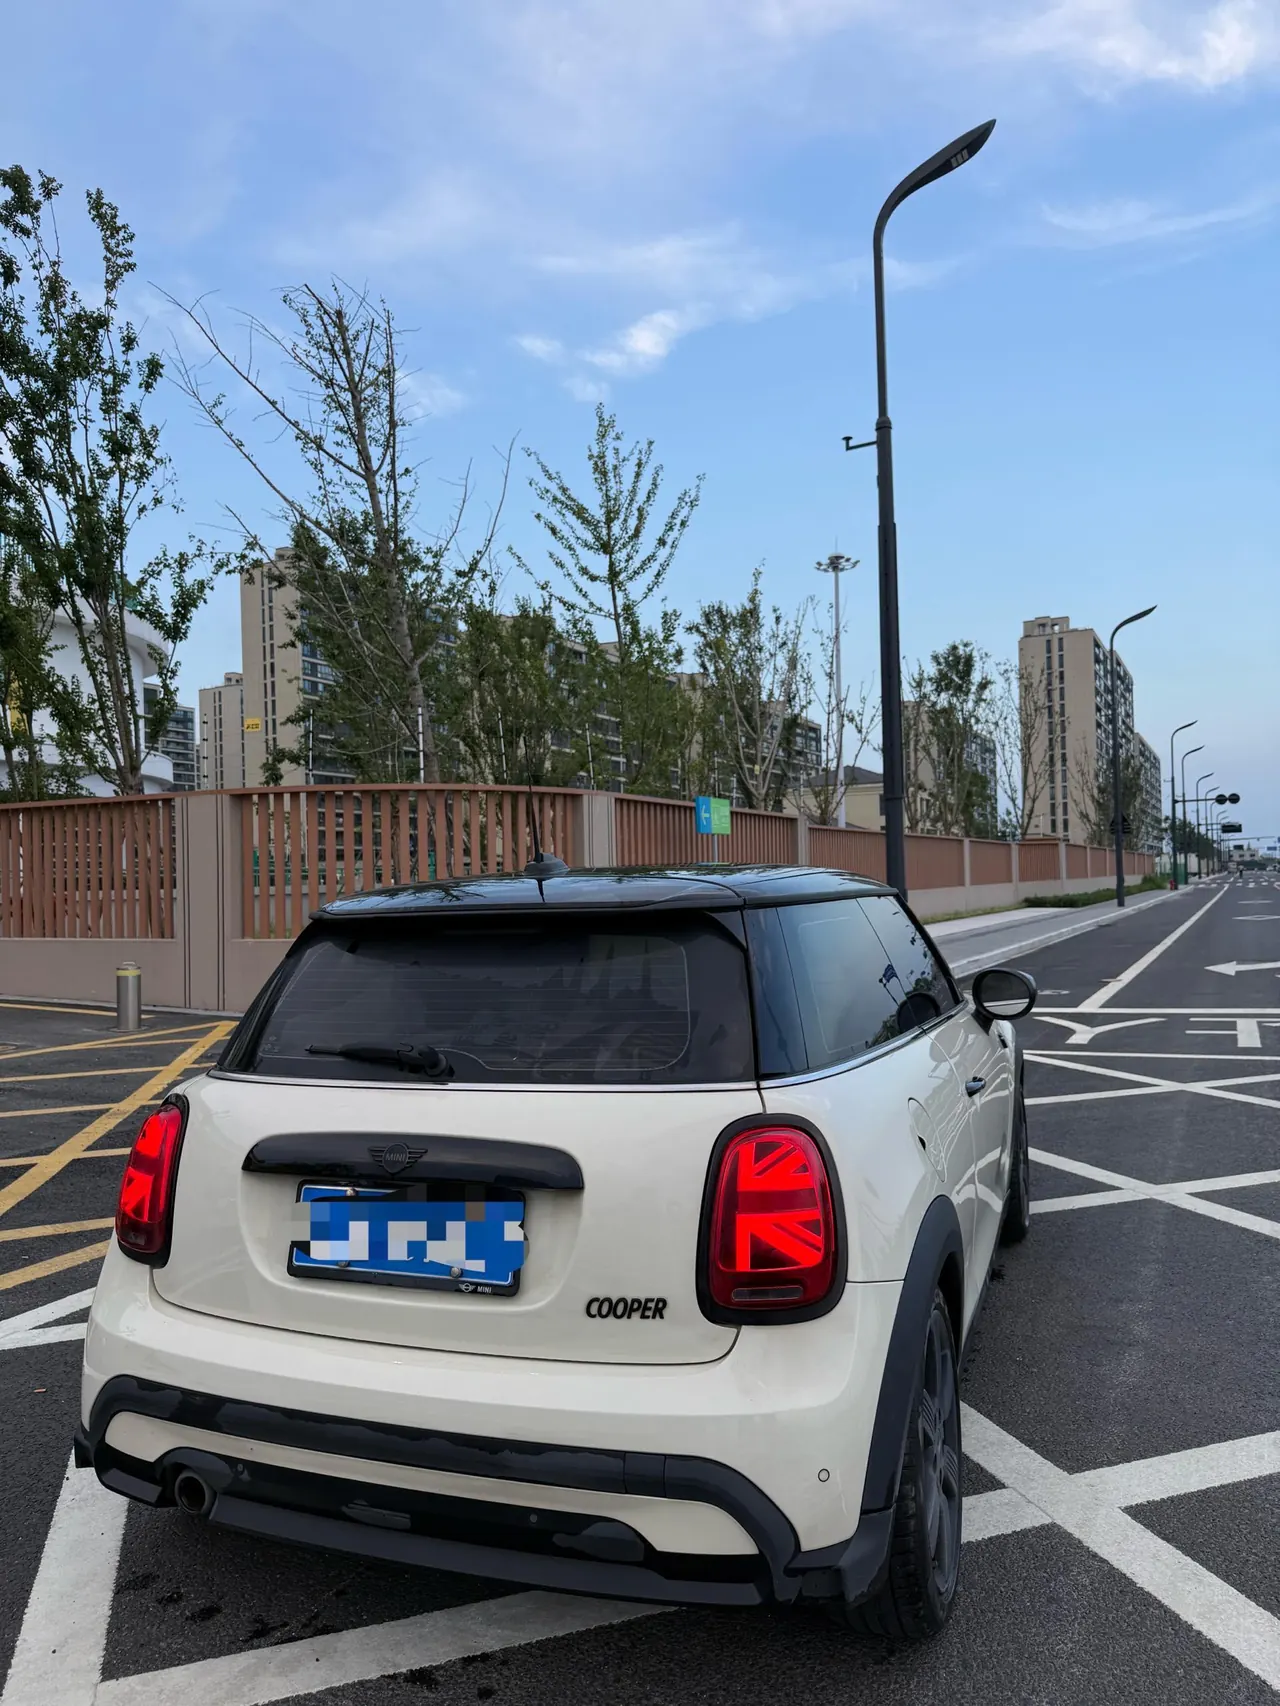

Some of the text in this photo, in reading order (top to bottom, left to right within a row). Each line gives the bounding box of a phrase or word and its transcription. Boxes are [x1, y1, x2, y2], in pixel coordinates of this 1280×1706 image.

[385, 1152, 406, 1162] MINI
[476, 1285, 492, 1294] MINI
[585, 1296, 668, 1320] COOPER
